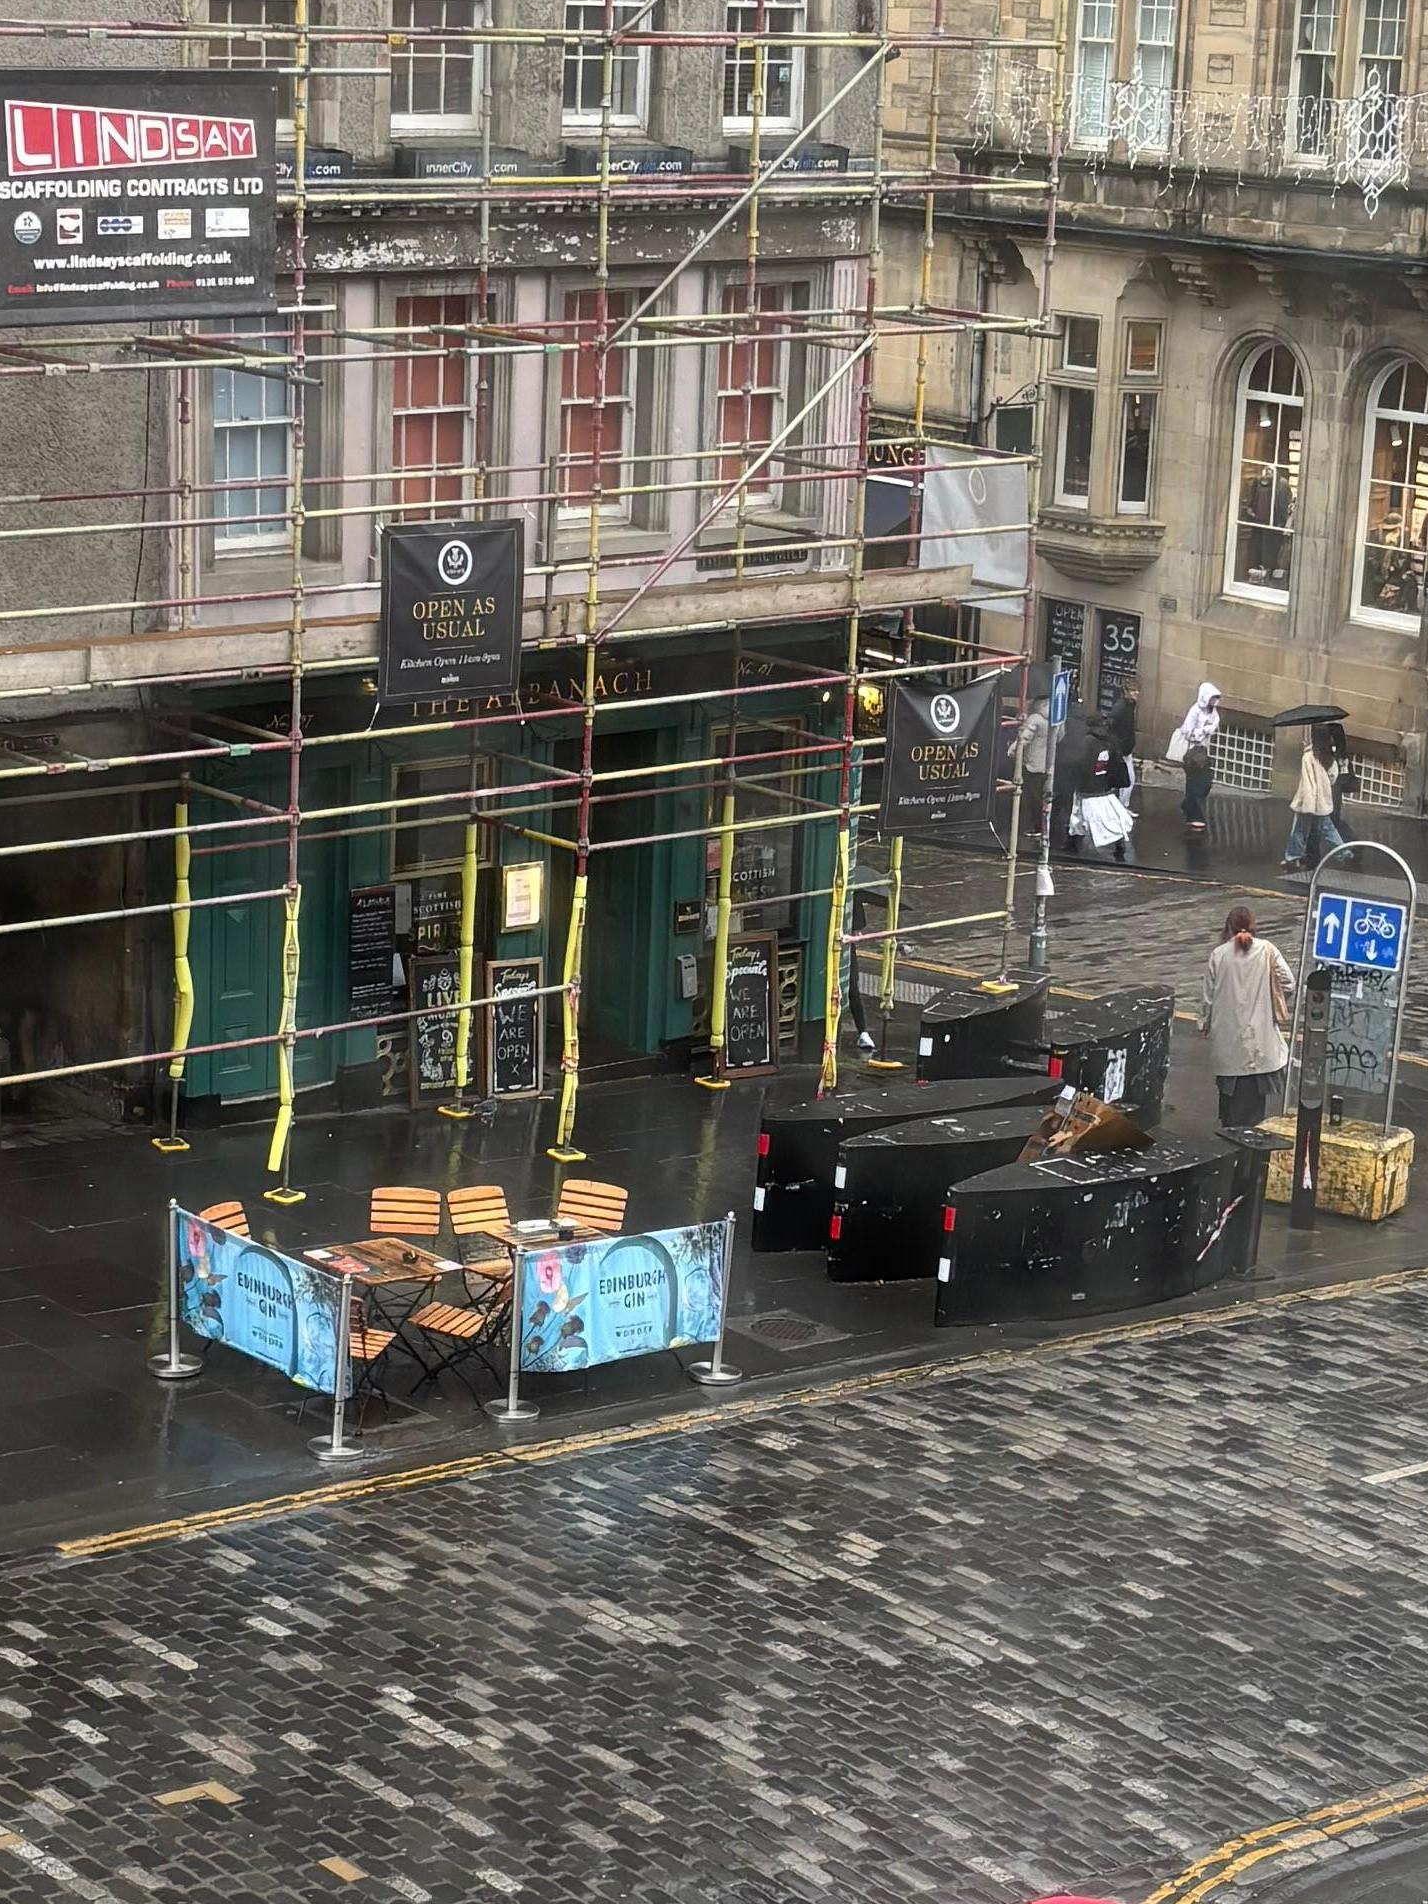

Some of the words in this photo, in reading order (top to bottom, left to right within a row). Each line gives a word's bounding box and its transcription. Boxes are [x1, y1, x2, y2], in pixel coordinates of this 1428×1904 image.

[13, 109, 250, 166] LINDSAY
[127, 178, 228, 197] CONTRACTS
[233, 177, 263, 195] LTD
[33, 250, 232, 271] www.lindsayscaffolding.co.uk
[413, 598, 465, 620] OPEN
[472, 596, 495, 615] AS
[423, 619, 485, 641] USUAL
[1104, 624, 1135, 652] 35
[434, 656, 457, 668] Open
[911, 744, 957, 763] OPEN
[962, 742, 979, 759] AS
[919, 762, 969, 781] USUAL
[732, 869, 775, 883] COTTISH
[730, 987, 751, 1002] WE
[498, 1005, 528, 1025] WE
[733, 1004, 757, 1019] ARE
[497, 1026, 525, 1040] ARE
[730, 1021, 765, 1041] OPEN
[497, 1043, 530, 1061] OPEN
[599, 1269, 666, 1295] EDINBURGH
[258, 1299, 276, 1319] GIN
[624, 1291, 645, 1309] GIN
